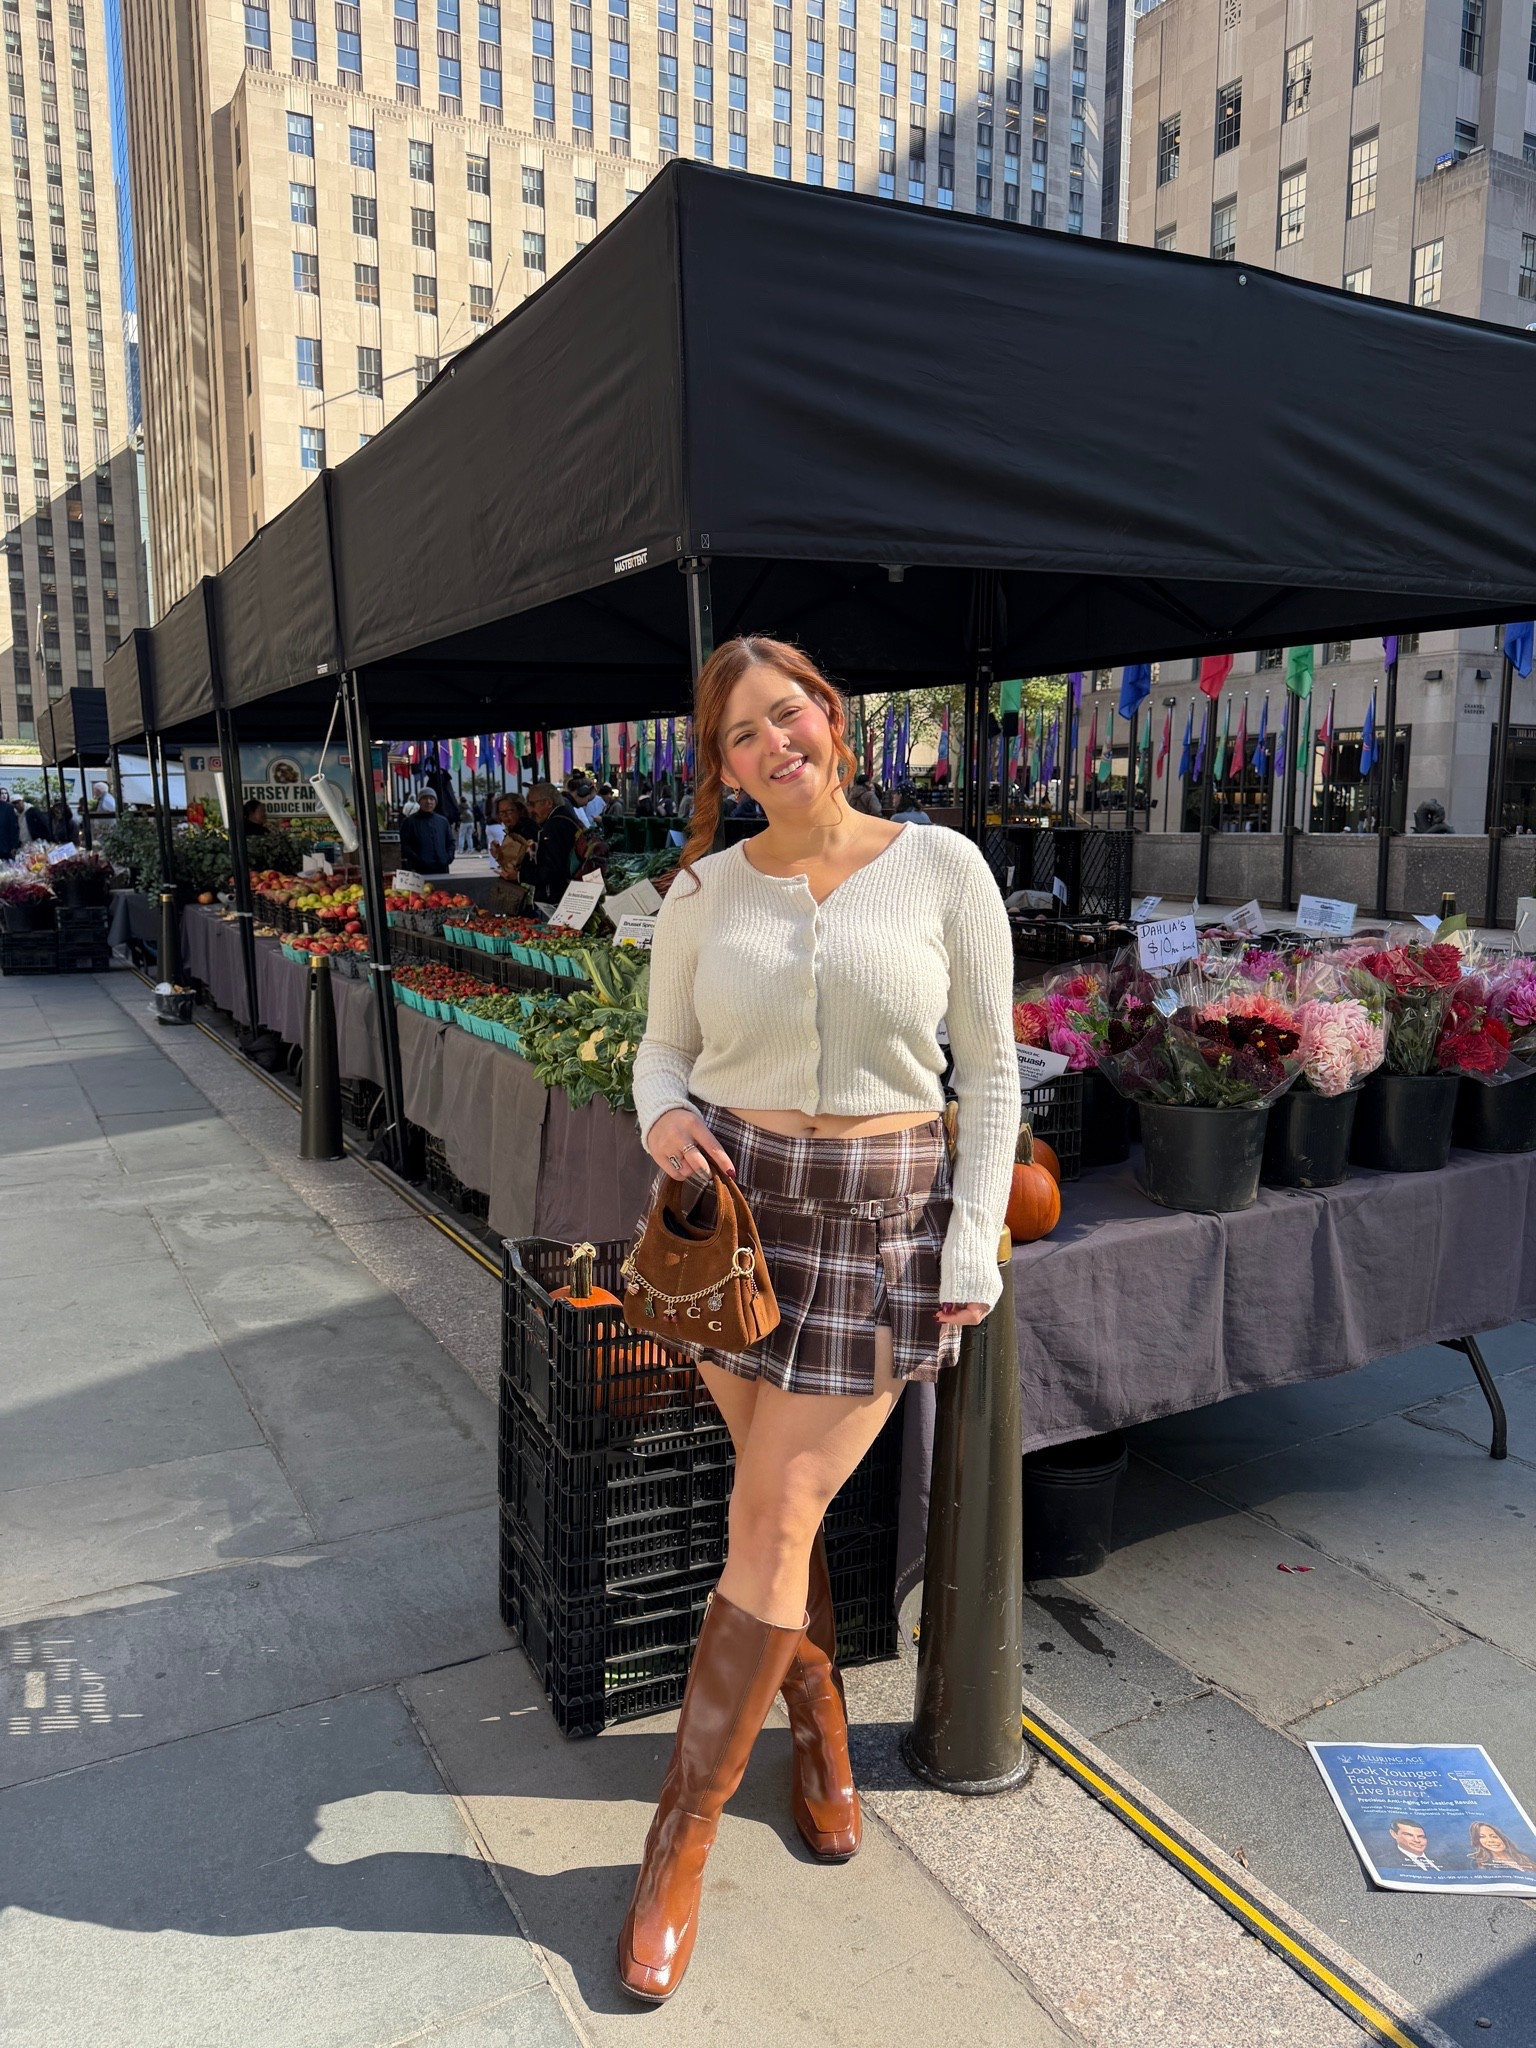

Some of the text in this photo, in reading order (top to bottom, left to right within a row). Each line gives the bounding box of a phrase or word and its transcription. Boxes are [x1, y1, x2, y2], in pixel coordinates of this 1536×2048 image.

[243, 786, 316, 800] JERSEY FAR
[266, 802, 300, 813] ODUCE
[1140, 920, 1187, 939] DAHLIA'S
[1147, 936, 1172, 960] $10
[1017, 1054, 1046, 1067] quash
[1357, 1754, 1403, 1763] ALLURING
[1342, 1765, 1379, 1776] Look
[1378, 1767, 1442, 1780] Younger.
[1347, 1775, 1443, 1791] Feel Stronger.
[1352, 1785, 1430, 1798] Live Better.
